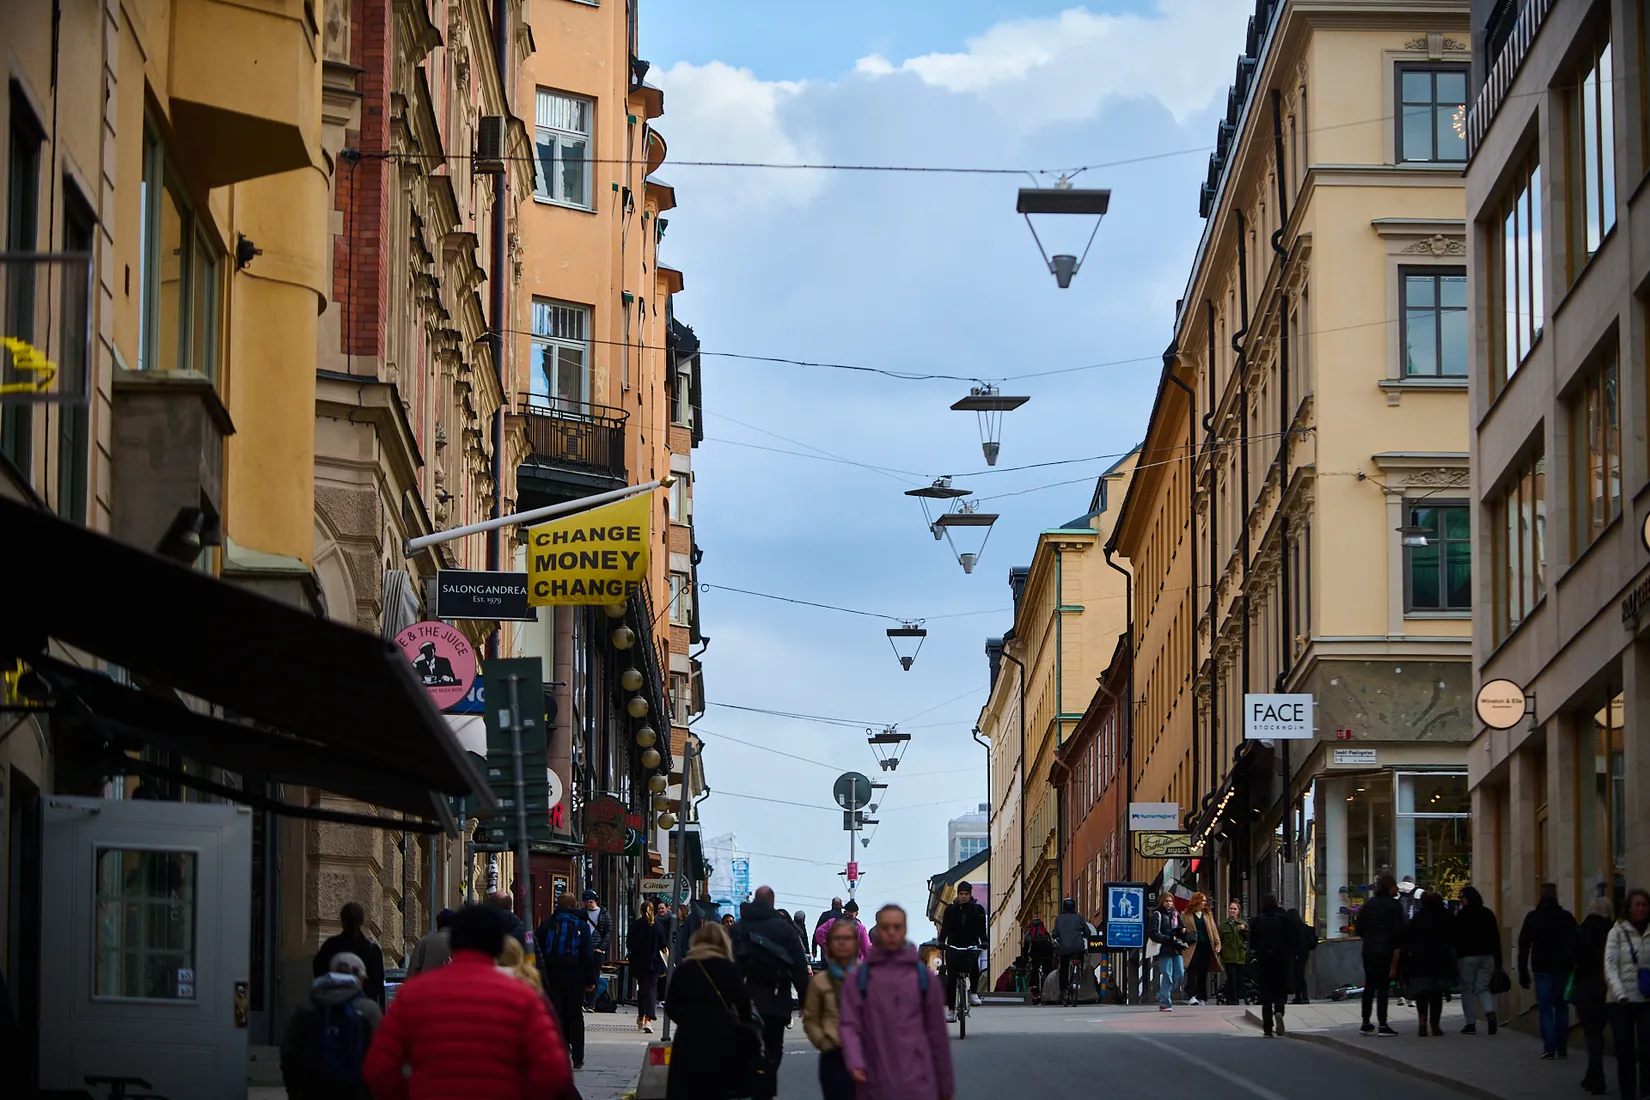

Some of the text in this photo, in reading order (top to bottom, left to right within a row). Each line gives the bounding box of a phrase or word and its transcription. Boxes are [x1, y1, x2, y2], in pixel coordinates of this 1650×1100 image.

[535, 526, 641, 547] CHANGE
[535, 551, 641, 573] MONEY
[534, 579, 639, 598] CHANGE
[417, 626, 440, 638] THE
[441, 631, 469, 657] JUICE
[1254, 704, 1304, 722] FACE
[1167, 847, 1188, 855] MUSIC
[643, 882, 670, 890] Glitter
